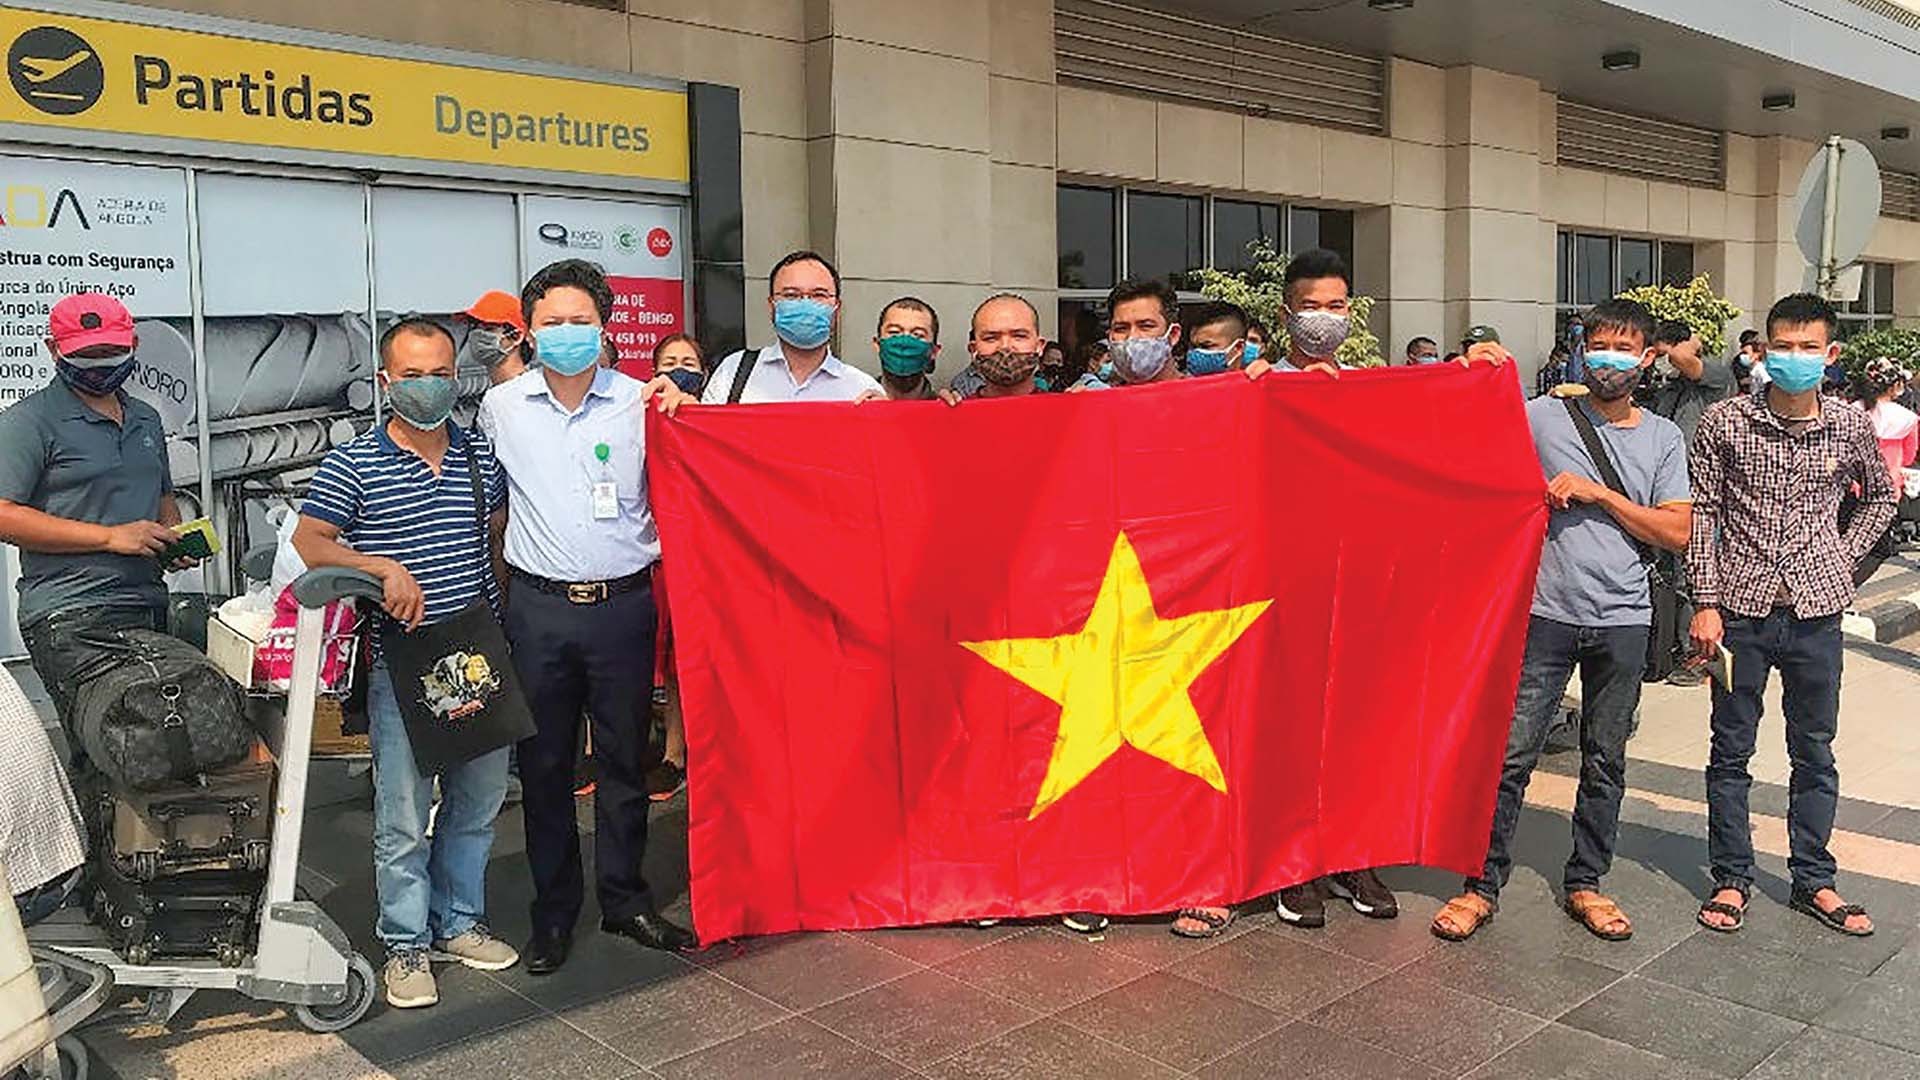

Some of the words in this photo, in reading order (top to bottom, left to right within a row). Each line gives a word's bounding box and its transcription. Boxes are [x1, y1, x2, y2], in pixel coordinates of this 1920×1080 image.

[135, 55, 374, 127] Partidas
[435, 95, 650, 153] Departures
[47, 254, 83, 268] com
[88, 252, 175, 272] Segurança
[35, 279, 55, 294] do
[107, 282, 136, 299] Aço
[638, 311, 674, 326] BENGO
[0, 321, 53, 340] ificaçã
[39, 366, 48, 379] e
